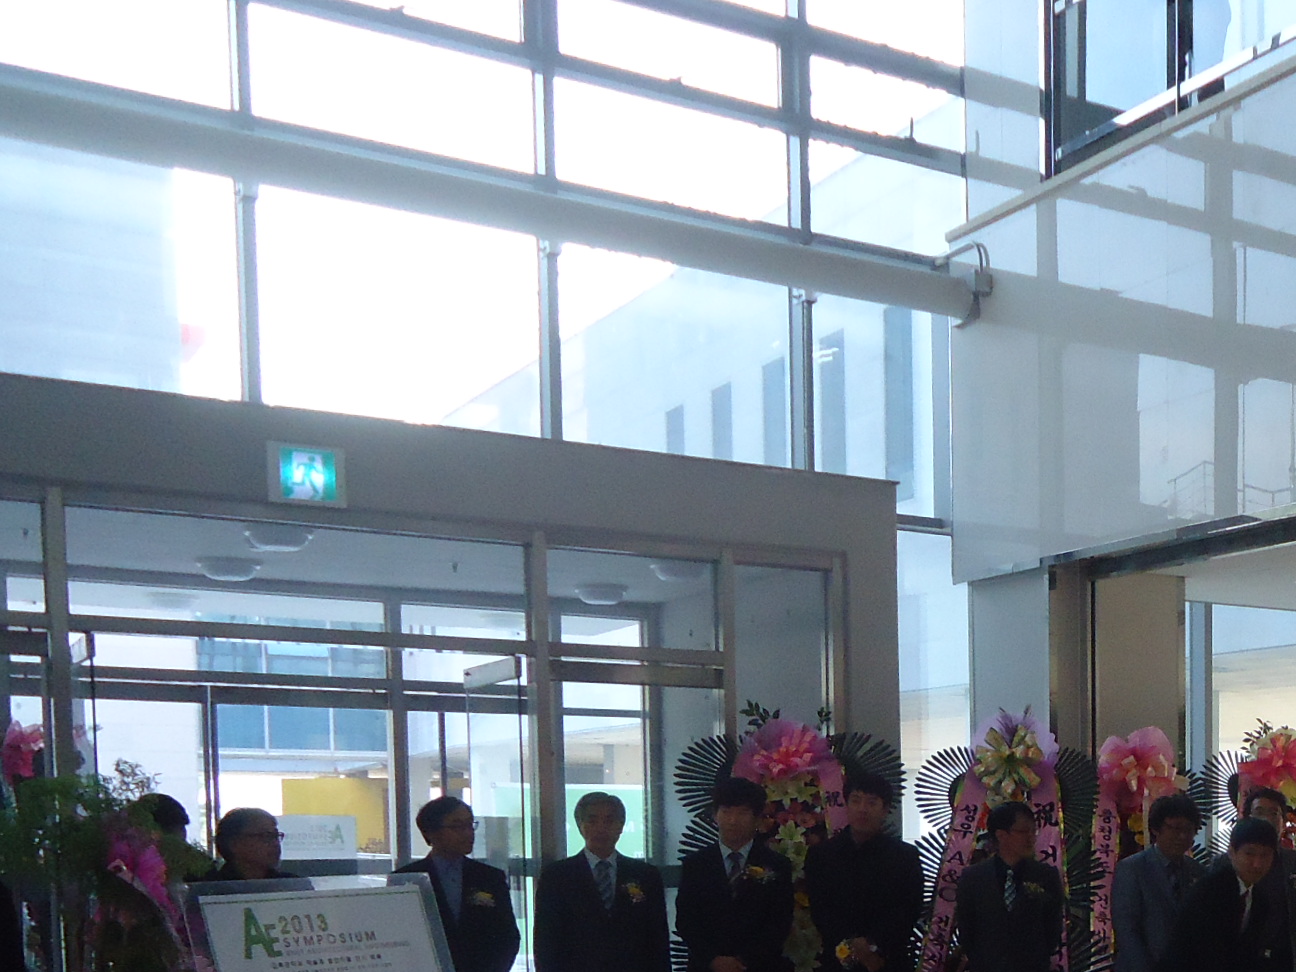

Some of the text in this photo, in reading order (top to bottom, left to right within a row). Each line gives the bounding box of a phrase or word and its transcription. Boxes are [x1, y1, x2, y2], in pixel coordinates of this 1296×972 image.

[959, 804, 979, 841] 성우
[1033, 801, 1059, 829] 祝
[277, 913, 329, 935] 2013
[282, 930, 378, 948] SYMPOSIUM
